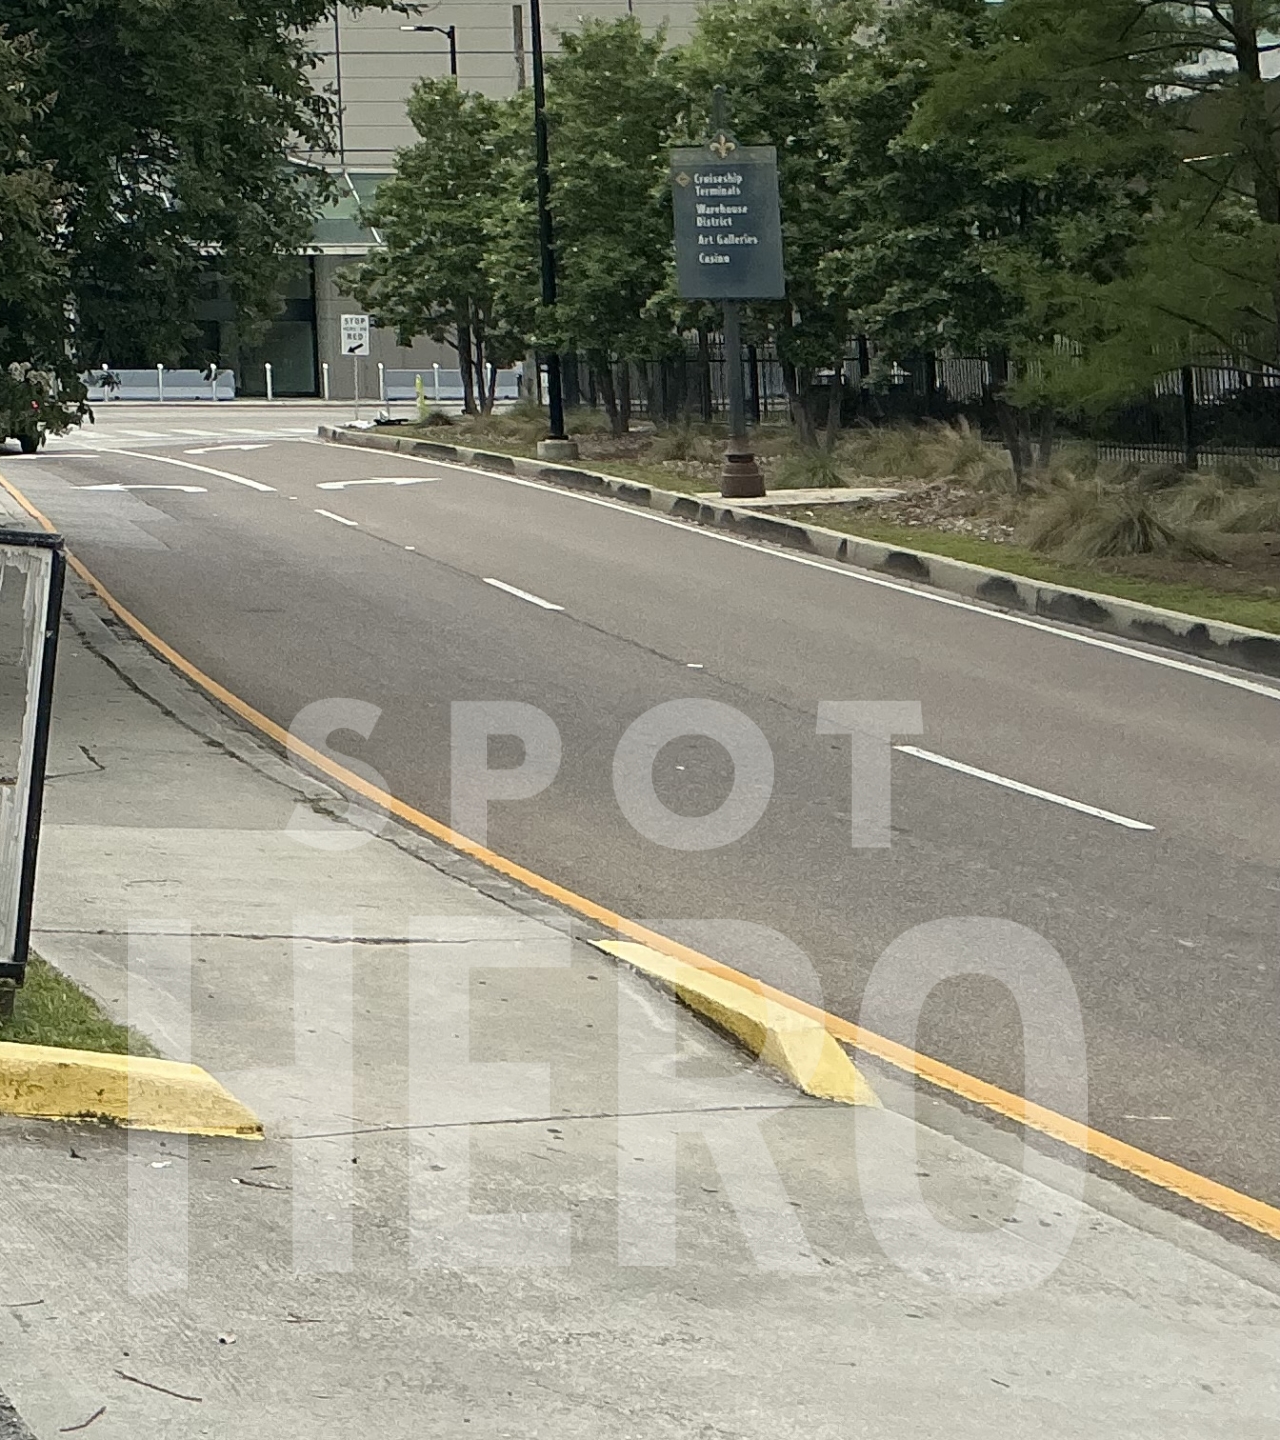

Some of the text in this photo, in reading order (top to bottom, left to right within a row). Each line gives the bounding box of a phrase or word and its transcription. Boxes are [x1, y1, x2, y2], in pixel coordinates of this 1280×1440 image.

[694, 172, 743, 184] Cruiseship
[695, 186, 741, 197] Terminals
[696, 203, 748, 215] Warehouse
[696, 216, 733, 227] District
[698, 233, 759, 245] Art Galleries
[698, 253, 730, 264] Casino
[347, 333, 364, 341] RED
